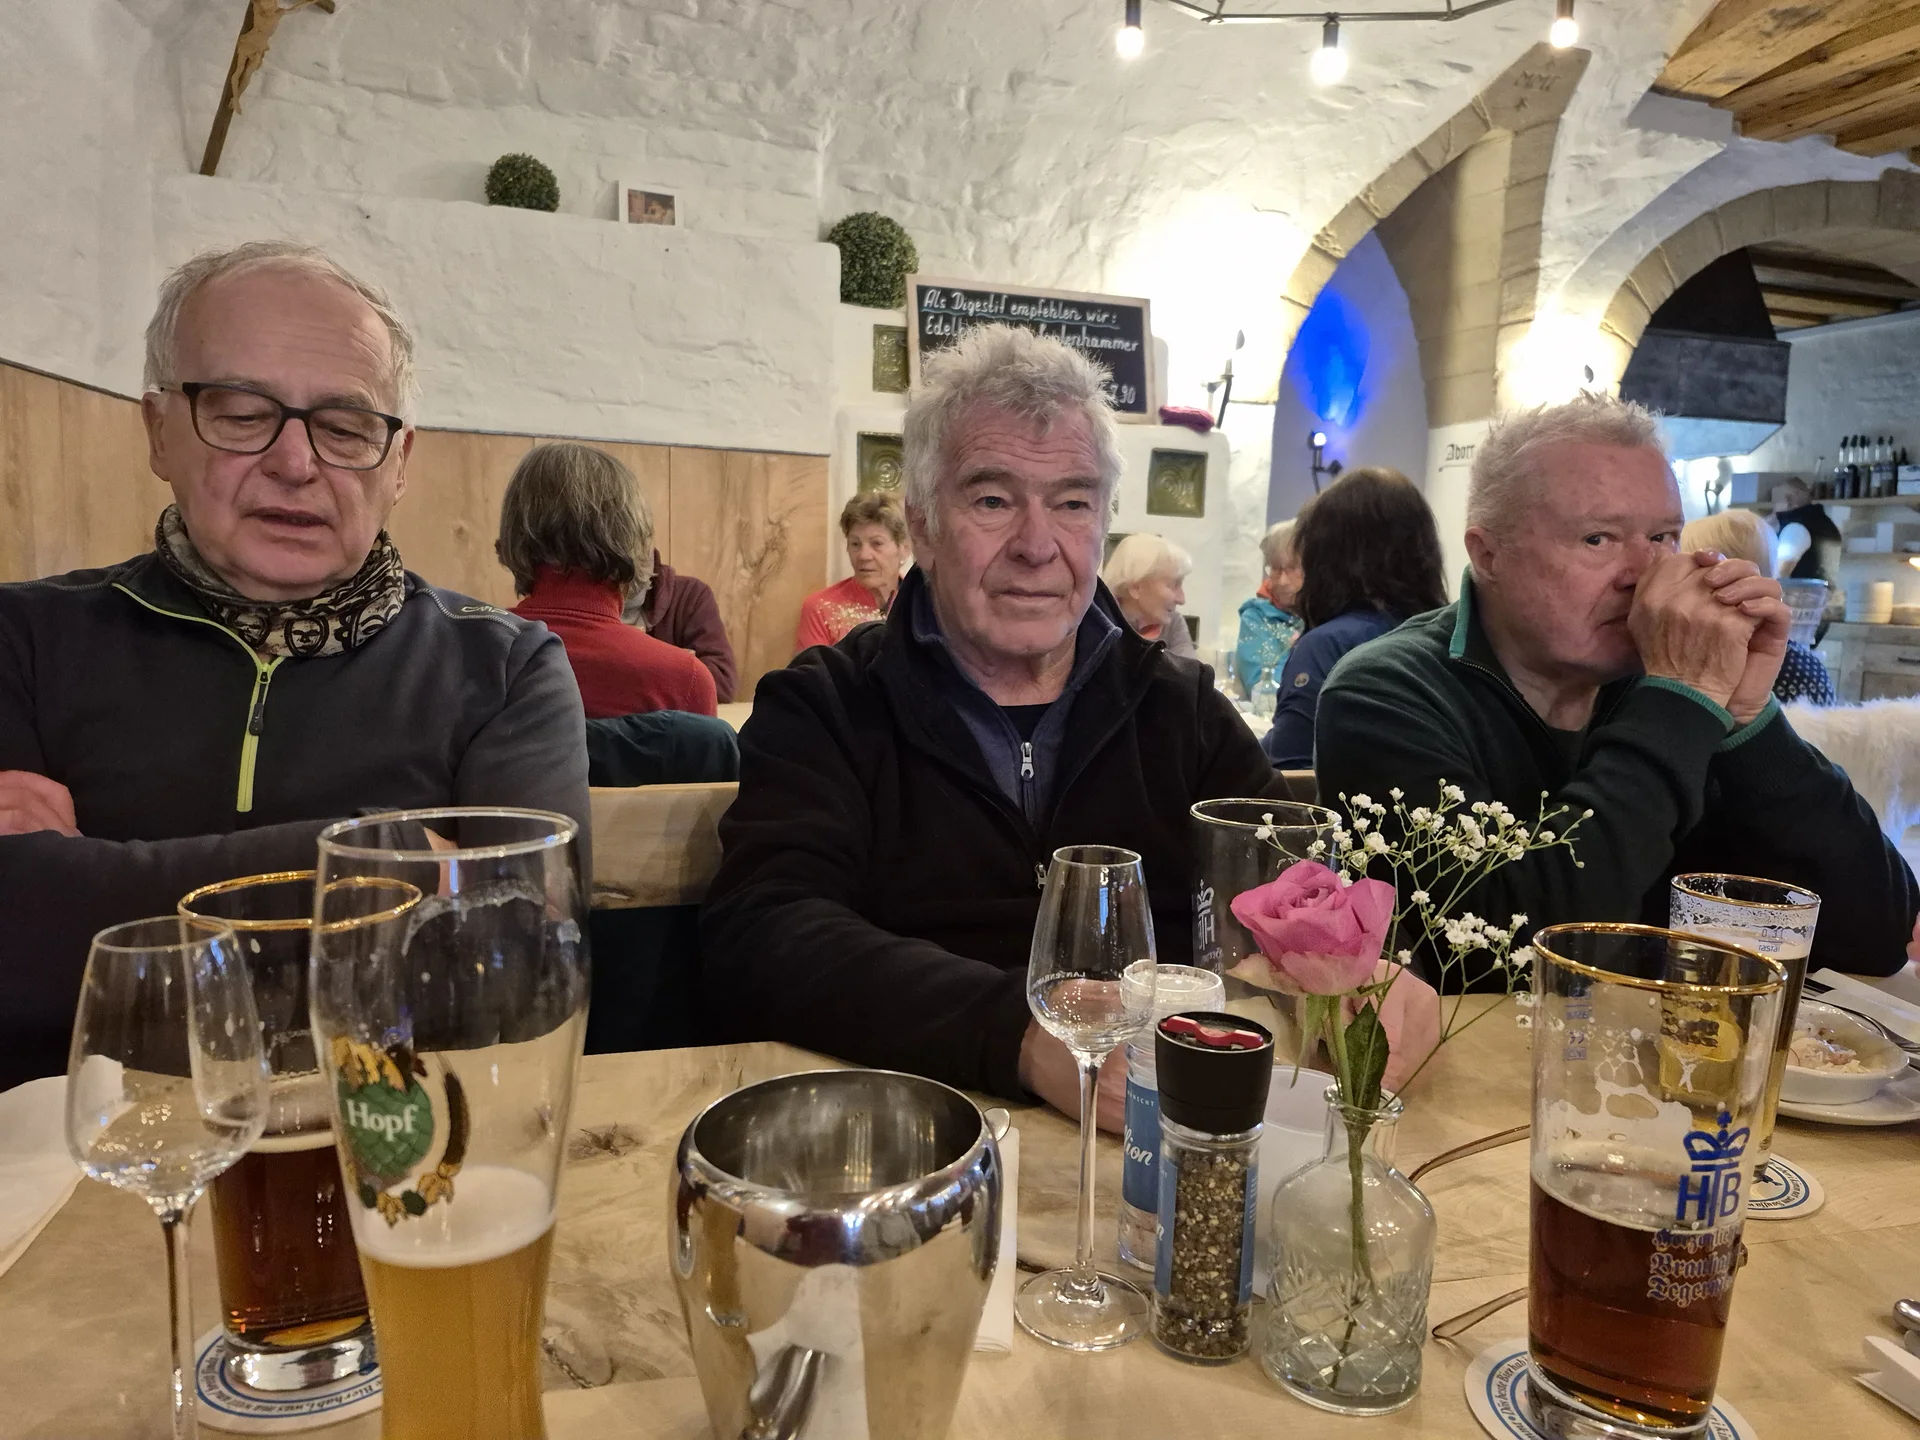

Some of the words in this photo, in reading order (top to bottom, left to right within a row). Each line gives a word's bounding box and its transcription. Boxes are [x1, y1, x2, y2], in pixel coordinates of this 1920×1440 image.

[923, 289, 947, 309] Als
[951, 291, 1008, 316] Digestif
[1010, 298, 1083, 320] empfehlen
[346, 1098, 420, 1143] Hopf
[1496, 1367, 1514, 1382] Bier
